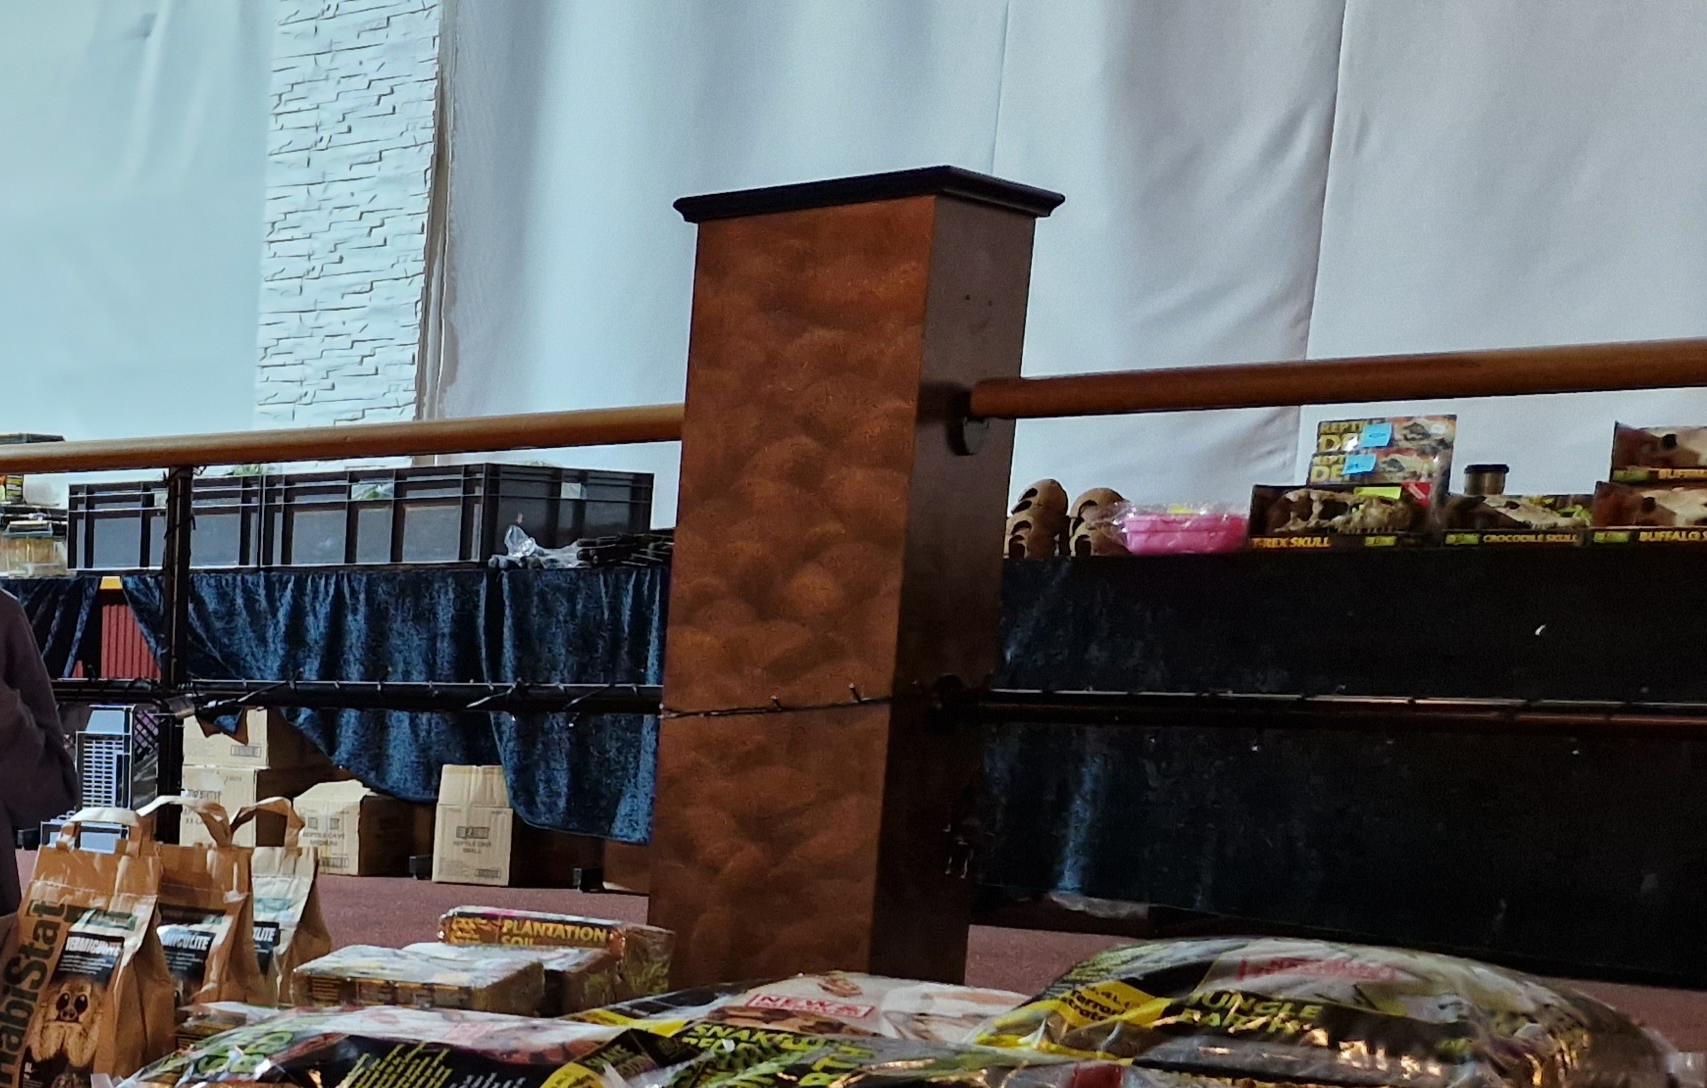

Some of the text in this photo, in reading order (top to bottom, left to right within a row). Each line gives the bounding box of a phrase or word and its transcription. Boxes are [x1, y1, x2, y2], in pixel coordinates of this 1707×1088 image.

[1290, 536, 1331, 548] SKULL
[501, 919, 607, 943] PLANTATION
[500, 934, 534, 946] SOIL
